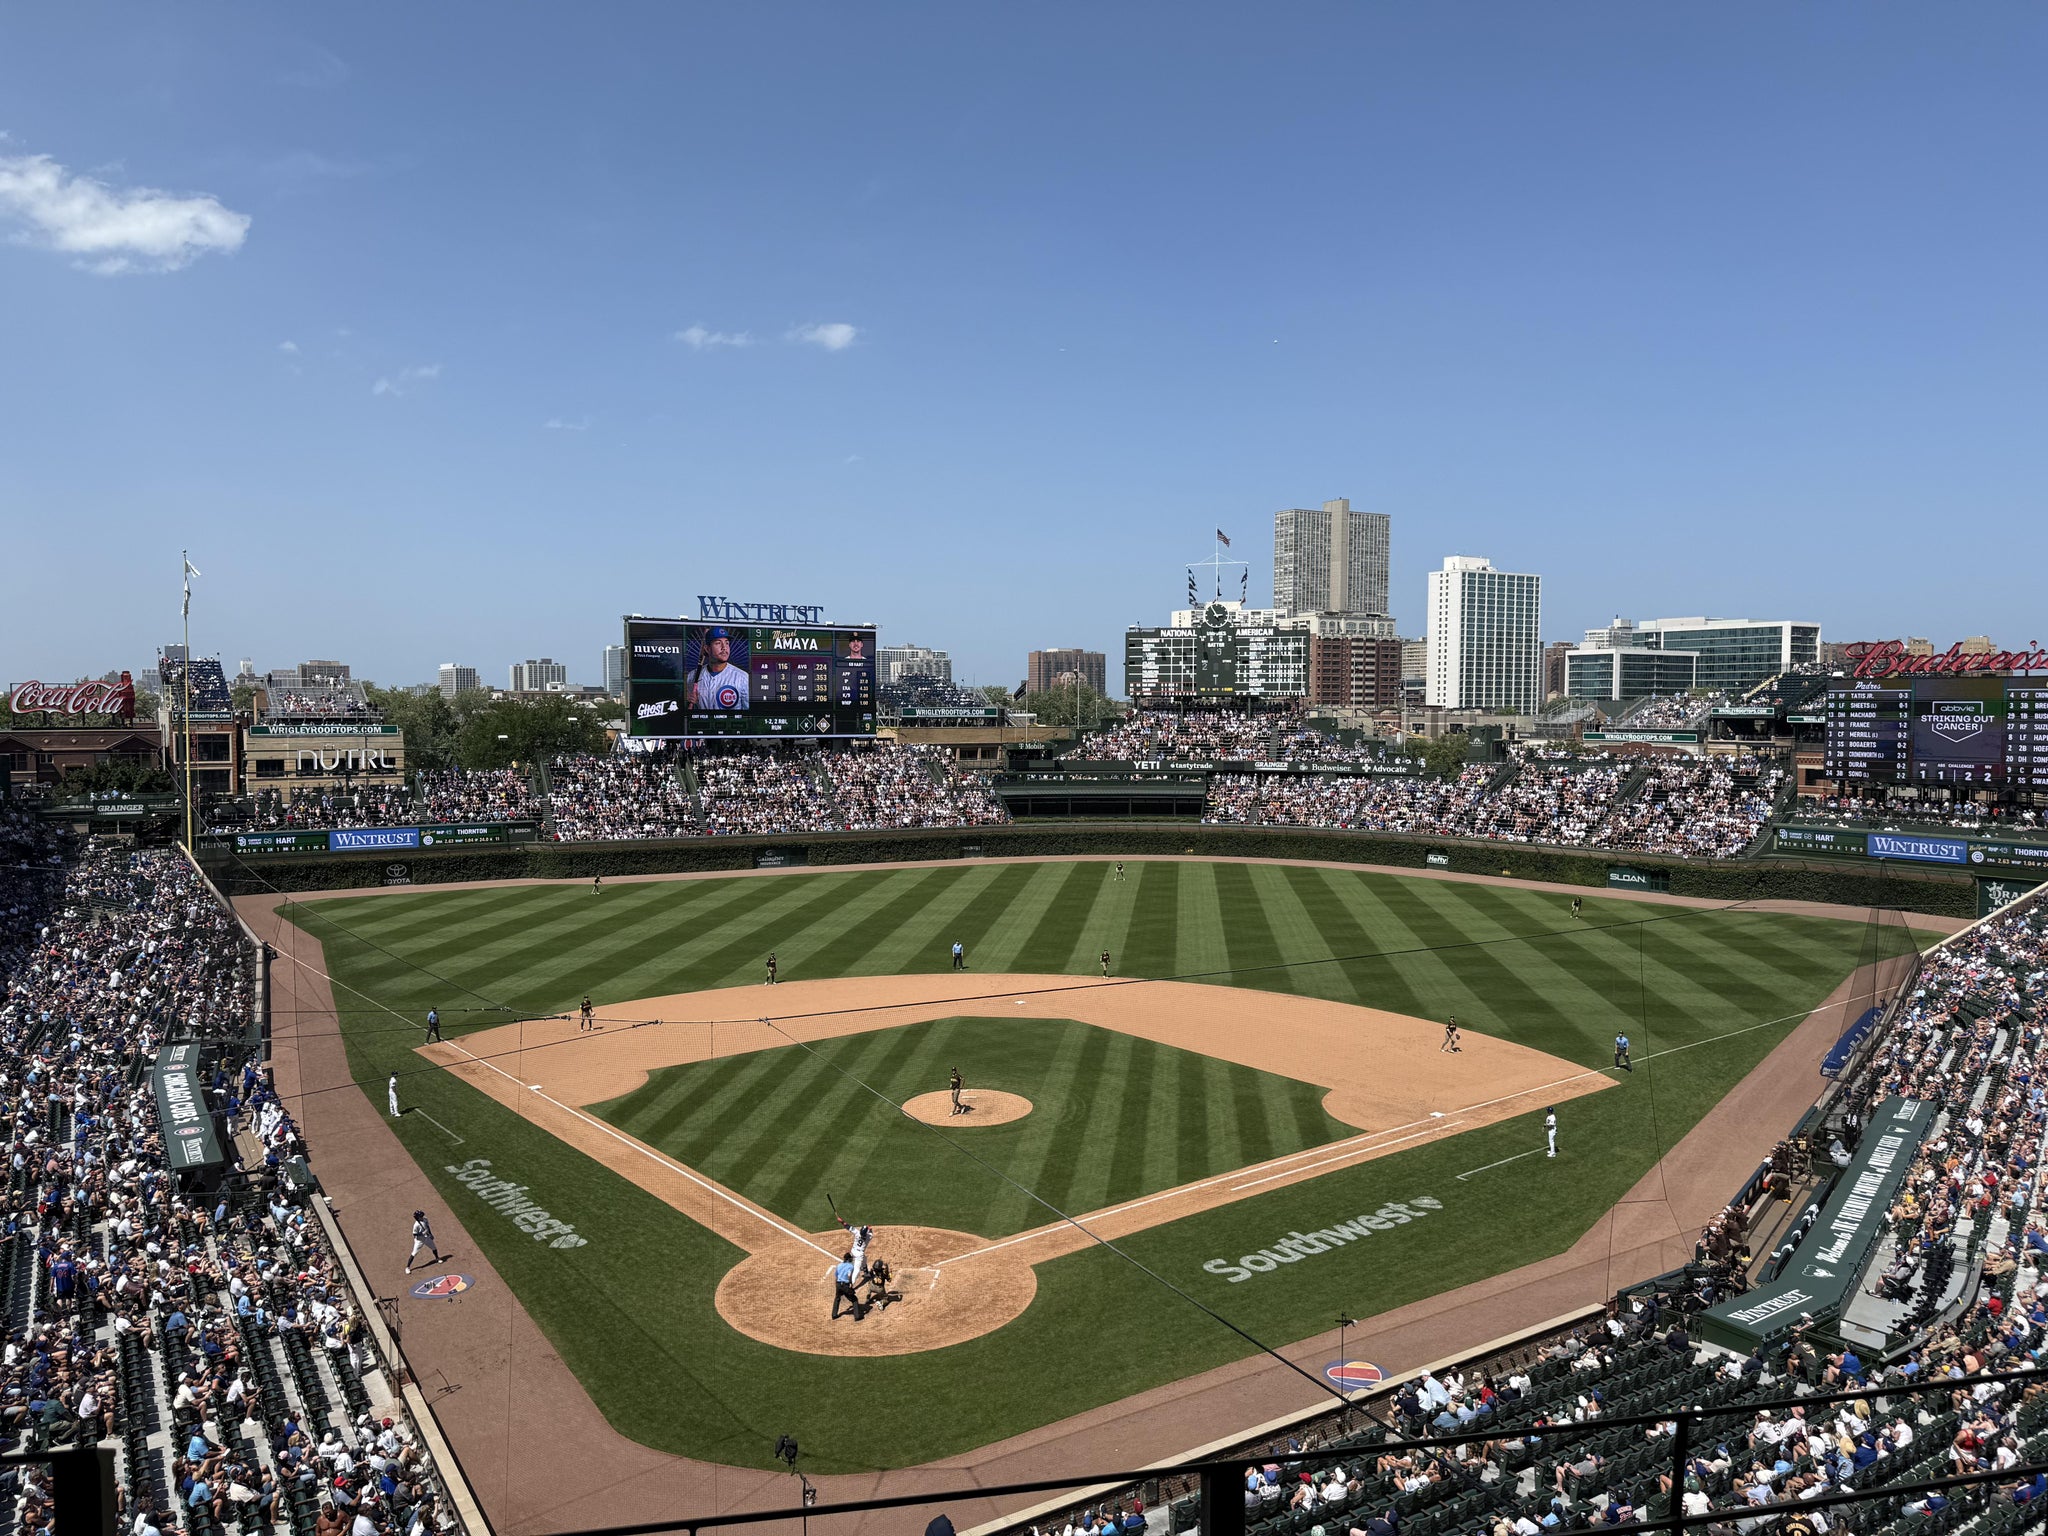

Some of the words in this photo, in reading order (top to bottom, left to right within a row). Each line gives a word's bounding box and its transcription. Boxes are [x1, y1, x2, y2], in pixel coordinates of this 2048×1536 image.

[697, 595, 824, 624] WINTRUST
[756, 629, 762, 637] 9
[772, 629, 797, 639] Miguel
[1161, 629, 1197, 637] NATIONAL
[1235, 628, 1274, 636] AMERICAN
[756, 641, 762, 650] C
[774, 638, 818, 650] AMAYA
[634, 645, 680, 654] nuveen
[1846, 640, 2048, 678] Budweis
[778, 662, 788, 670] 116
[814, 674, 828, 682] .353
[814, 684, 828, 692] .353
[1855, 681, 1882, 690] Padres
[11, 681, 131, 715] Coca-Cola
[780, 694, 787, 702] 19
[814, 694, 828, 702] .706
[638, 700, 671, 716] GHOST
[916, 708, 985, 716] WRIGLEYROOFTOPS.COM
[1921, 714, 1971, 722] STRIKING
[1973, 715, 1995, 723] OUT
[269, 726, 382, 734] WRIGLEYROOFTOPS.COM
[865, 723, 870, 731] 9
[1936, 722, 1979, 731] CANCER
[1133, 761, 1160, 770] YETI
[1175, 762, 1214, 770] tastytrade
[1312, 764, 1350, 772] Budweiser
[1372, 764, 1407, 773] Advocate
[1920, 770, 1926, 779] 1
[1938, 771, 1944, 780] 1
[1964, 772, 1972, 781] 2
[1984, 773, 1992, 782] 2
[97, 804, 144, 812] GRAINGER
[336, 833, 413, 845] WINTRUST
[1815, 834, 1834, 842] HART
[1874, 837, 1961, 857] WINTRUST
[2014, 847, 2048, 857] THORNTO
[1429, 855, 1447, 864] Hefty
[1610, 873, 1645, 883] SLOAN
[163, 1072, 193, 1103] CHICAGO
[170, 1101, 199, 1126] CUBS
[1877, 1135, 1904, 1150] FIELD
[1867, 1146, 1897, 1168] WRIGLEY
[1851, 1171, 1885, 1197] CONFINES
[444, 1159, 577, 1242] Southwest
[1837, 1194, 1873, 1222] FRIENDLY
[1830, 1218, 1860, 1234] THE
[1203, 1202, 1428, 1283] Southwest
[1815, 1240, 1849, 1264] Welcome
[1727, 1289, 1807, 1322] WINTRUST
